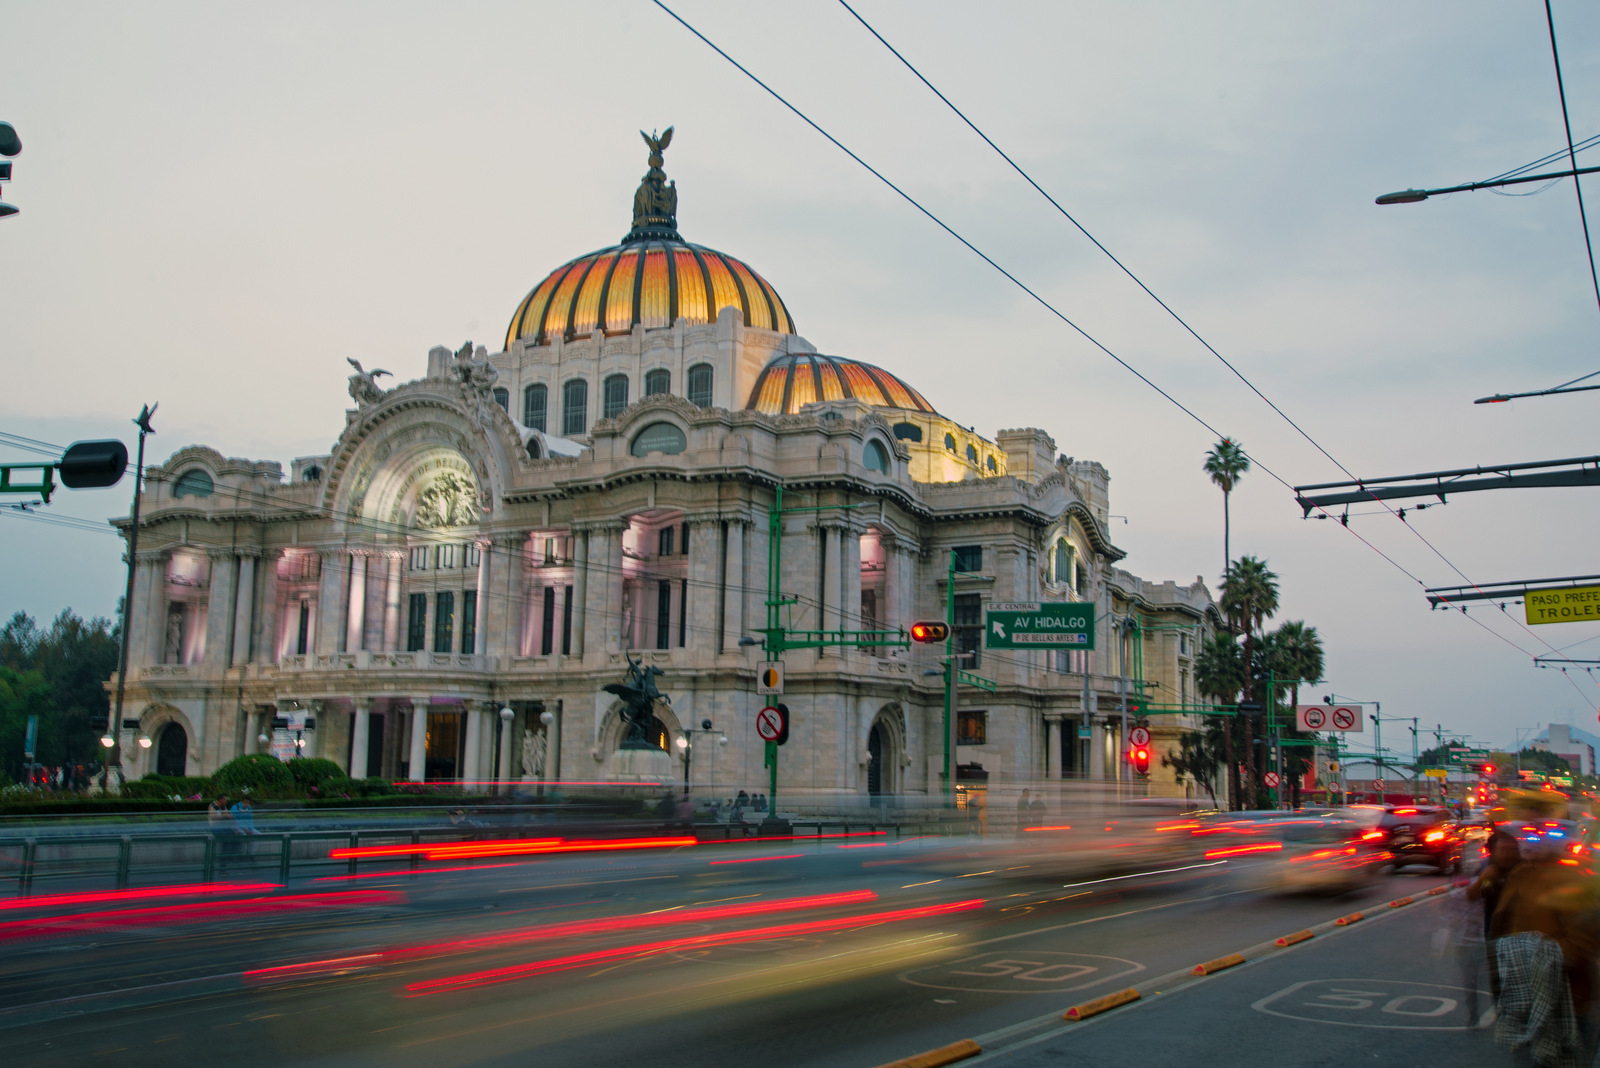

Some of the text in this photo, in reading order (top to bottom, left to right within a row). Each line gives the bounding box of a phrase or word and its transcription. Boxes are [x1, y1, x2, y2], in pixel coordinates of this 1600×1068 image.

[1531, 594, 1560, 605] PASO
[1014, 617, 1086, 628] AV HIDALGO
[951, 959, 1099, 982] 50
